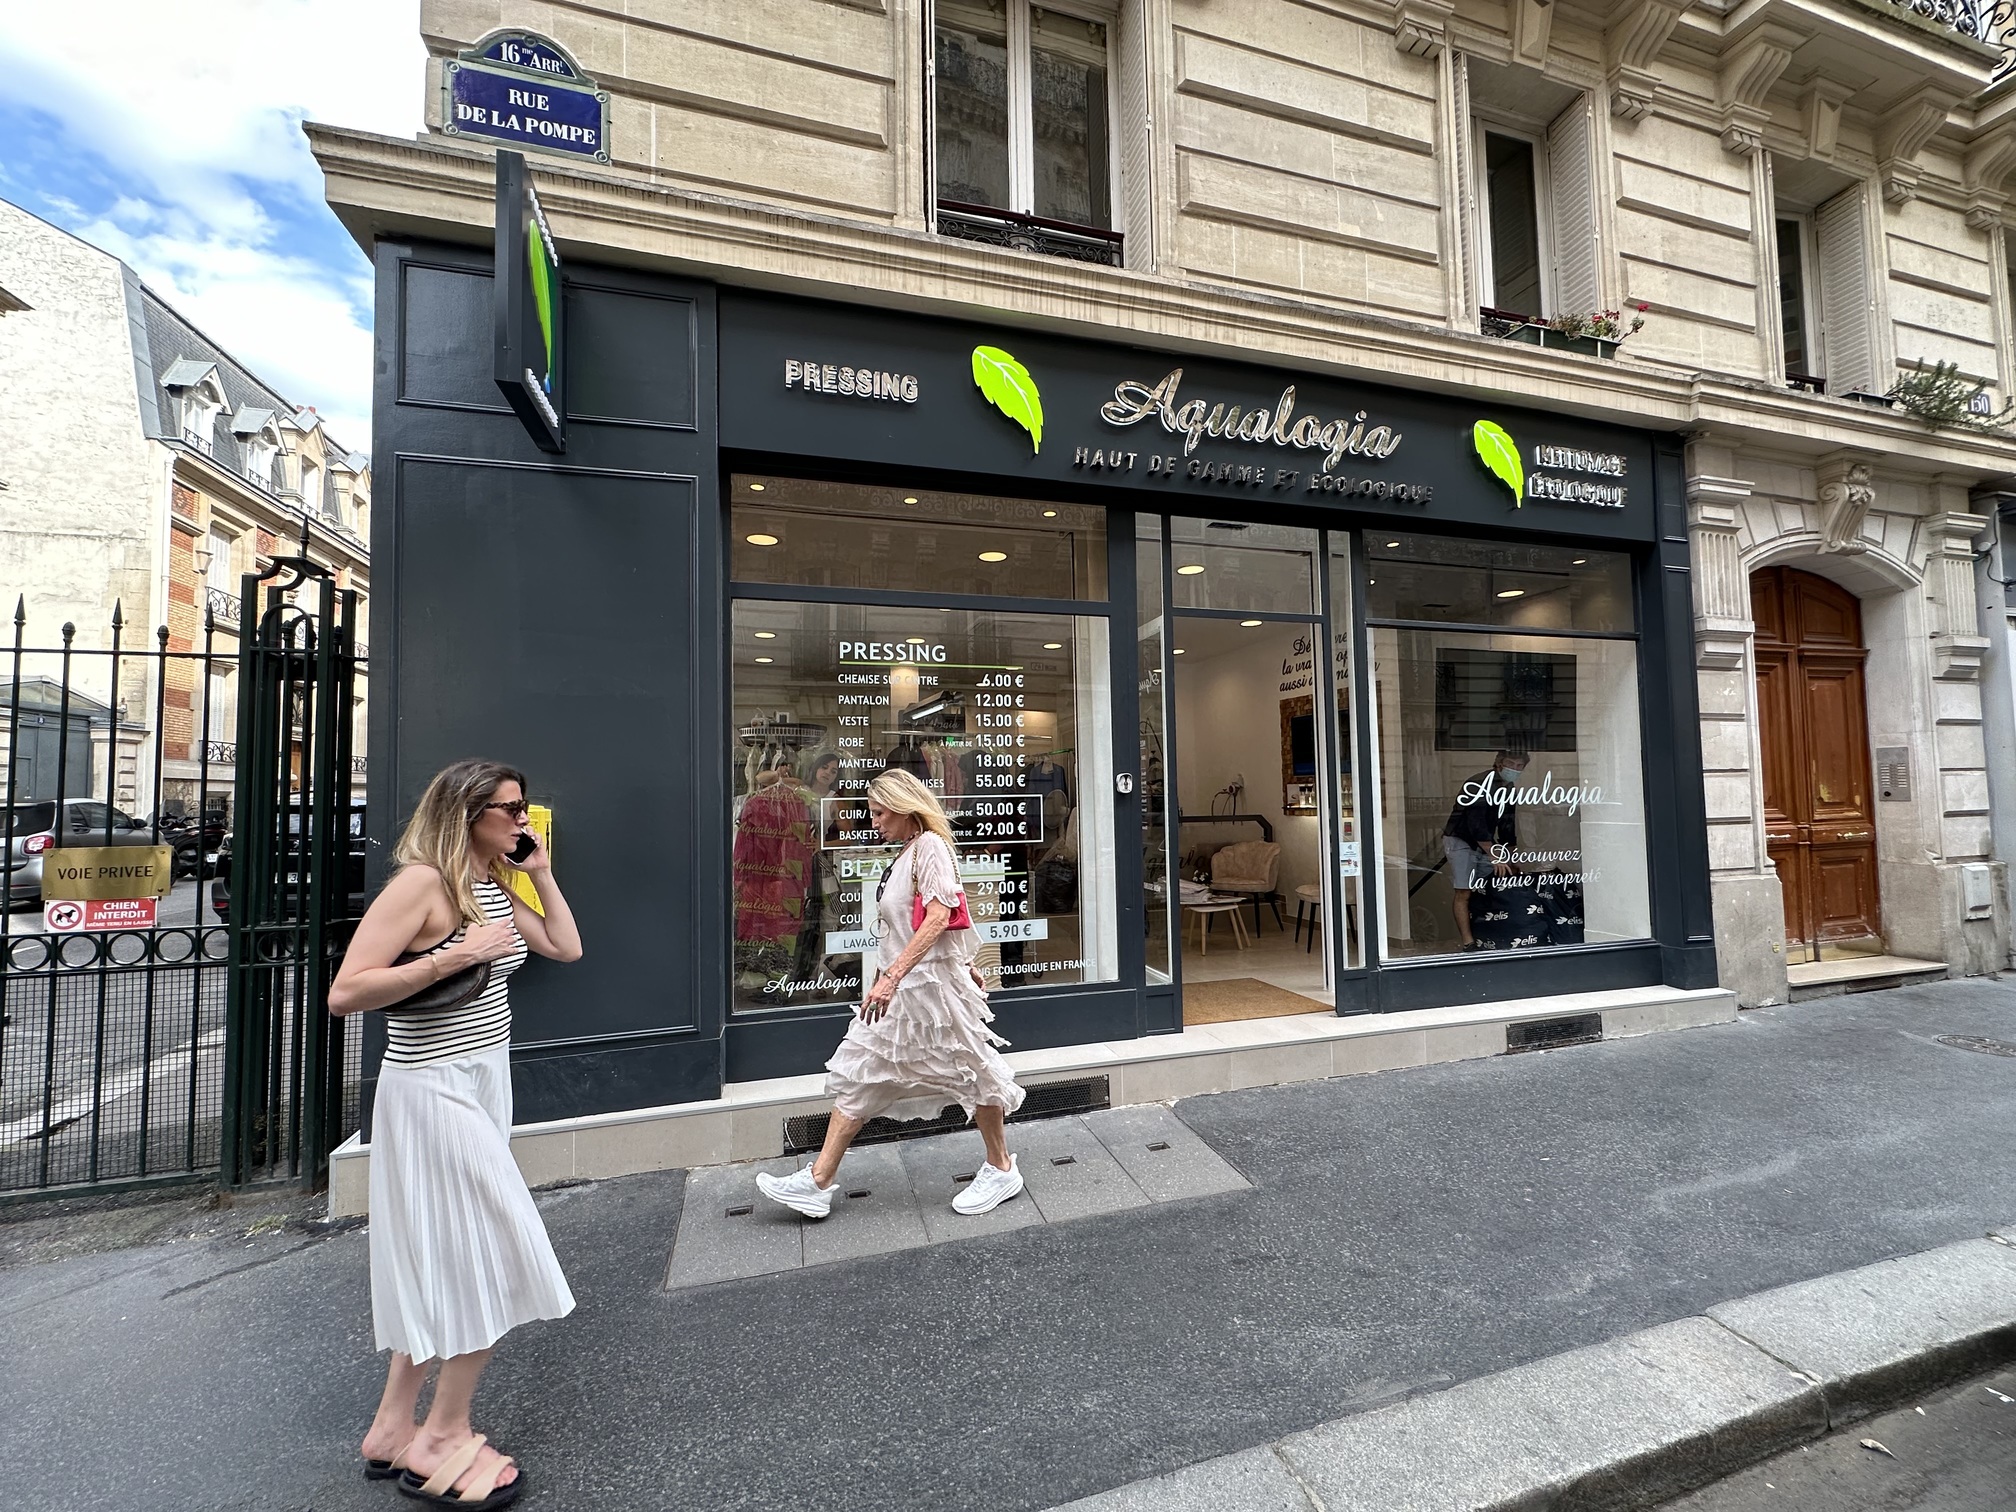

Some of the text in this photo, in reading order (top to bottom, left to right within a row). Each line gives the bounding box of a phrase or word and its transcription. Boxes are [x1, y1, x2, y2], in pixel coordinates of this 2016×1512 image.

[508, 88, 549, 111] RUE
[457, 103, 595, 145] DE LA POMPE
[785, 359, 919, 403] PRESSING
[1101, 368, 1402, 472] Aqualogia
[1535, 445, 1628, 476] NETTOYAGE
[1073, 446, 1434, 502] HAUT DE GAMME ET ECOLOGIQUE
[839, 641, 946, 662] PRESSING
[838, 674, 880, 685] CHEMISE
[982, 674, 1011, 688] 6.00
[1015, 674, 1024, 688] €
[1280, 675, 1307, 692] aussi
[838, 694, 1024, 708] PANTALON 12.00 €
[838, 716, 869, 726] VESTE
[975, 714, 1012, 728] 15.00
[1016, 714, 1024, 727] €
[838, 738, 865, 747] ROBE
[945, 740, 965, 748] PARTIR
[975, 734, 1012, 748] 15.00
[1016, 734, 1025, 747] €
[838, 754, 1025, 768] MANTEAU 18.00 €
[975, 774, 1013, 788] 55.00
[1017, 774, 1026, 787] €
[1456, 771, 1605, 818] Aqualogia
[838, 809, 867, 820] CUIR/
[976, 802, 1013, 816] 50.00
[1017, 802, 1026, 816] €
[739, 822, 790, 837] Aqualogia
[839, 829, 879, 840] BASKETS
[976, 822, 1014, 836] 29.00
[1017, 822, 1027, 835] €
[1490, 842, 1583, 865] Découvrez
[57, 865, 154, 880] VOIE PRIVEE
[1468, 867, 1602, 893] la vraie propreté
[977, 881, 1015, 895] 29.00
[1018, 880, 1028, 893] €
[103, 901, 139, 910] CHIEN
[734, 898, 782, 915] qualogia
[977, 902, 1015, 916] 39.00
[1019, 901, 1028, 914] €
[93, 910, 148, 920] INTERDIT
[1493, 911, 1509, 921] elis
[1567, 916, 1583, 925] elis
[843, 924, 1031, 948] LAVAGE 5.90 €
[1521, 935, 1538, 946] elis
[993, 962, 1048, 976] ECOLOGIQUE
[1050, 961, 1061, 971] EN
[1063, 959, 1097, 969] FRANCE
[763, 971, 860, 997] Aqualogia
